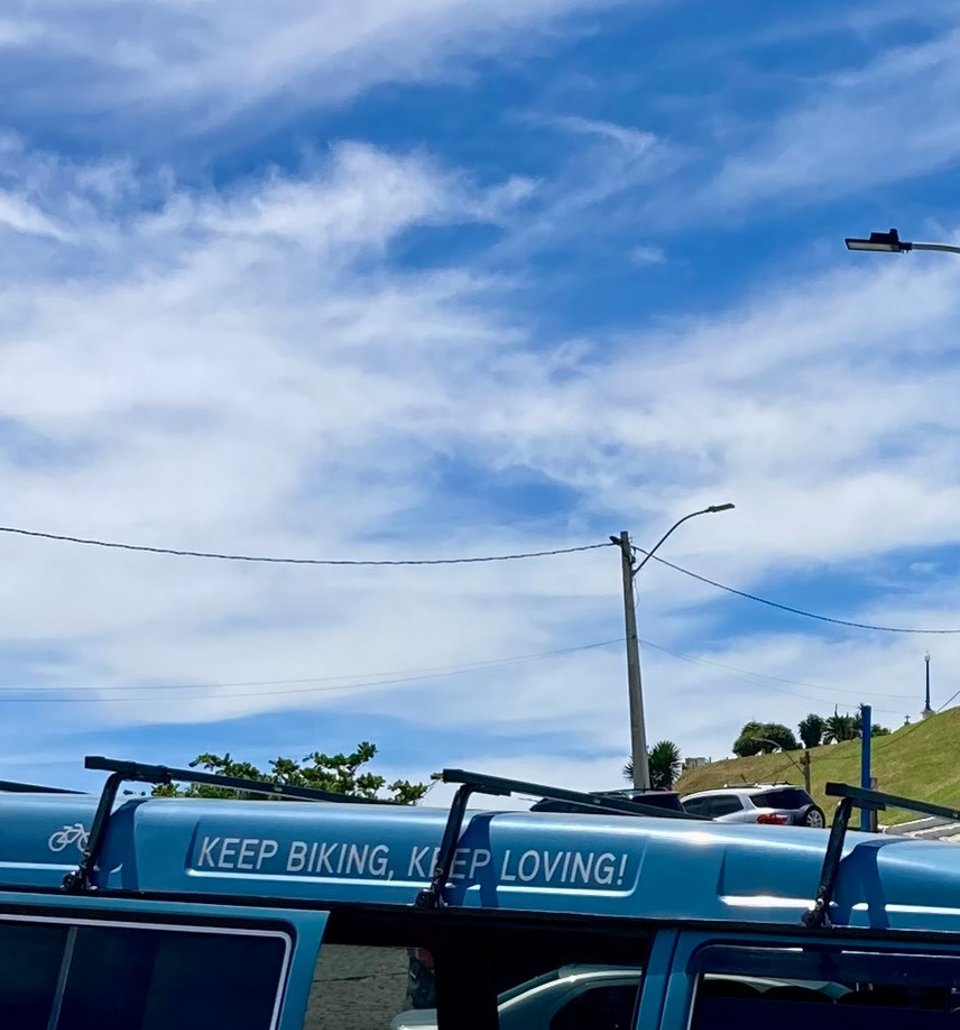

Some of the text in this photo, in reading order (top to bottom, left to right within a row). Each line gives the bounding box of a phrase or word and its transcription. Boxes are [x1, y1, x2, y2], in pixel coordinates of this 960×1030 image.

[198, 836, 278, 869] KEEP
[286, 841, 394, 882] BIKING,
[501, 849, 628, 886] LOVING!
